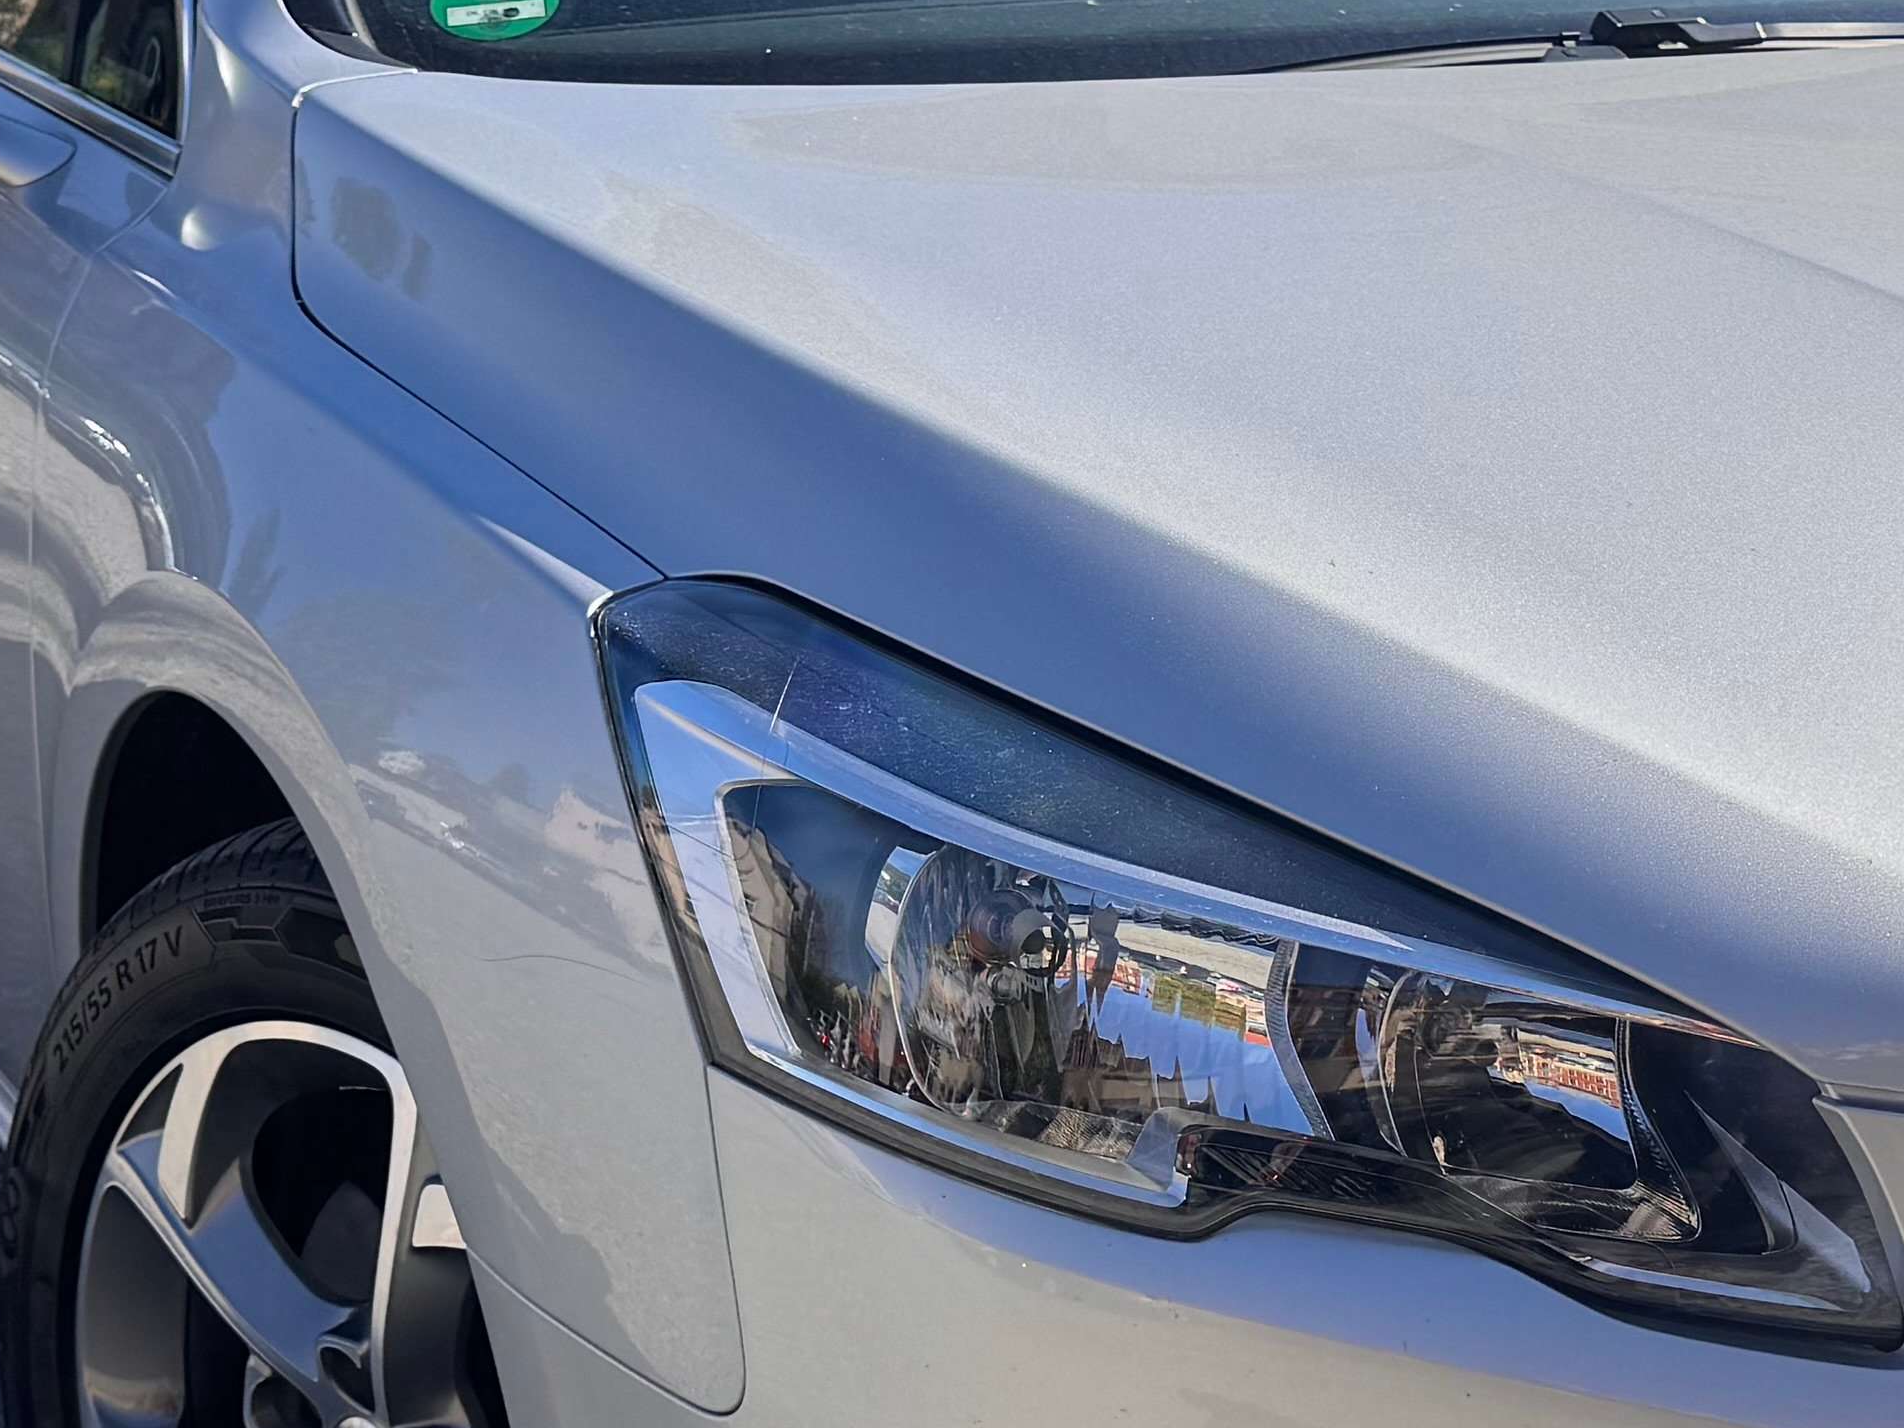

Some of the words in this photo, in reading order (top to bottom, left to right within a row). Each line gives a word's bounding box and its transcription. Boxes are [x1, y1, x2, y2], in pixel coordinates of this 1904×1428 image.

[52, 979, 112, 1072] 215/55
[115, 960, 134, 990] R
[136, 937, 158, 972] 17
[164, 925, 184, 957] V
